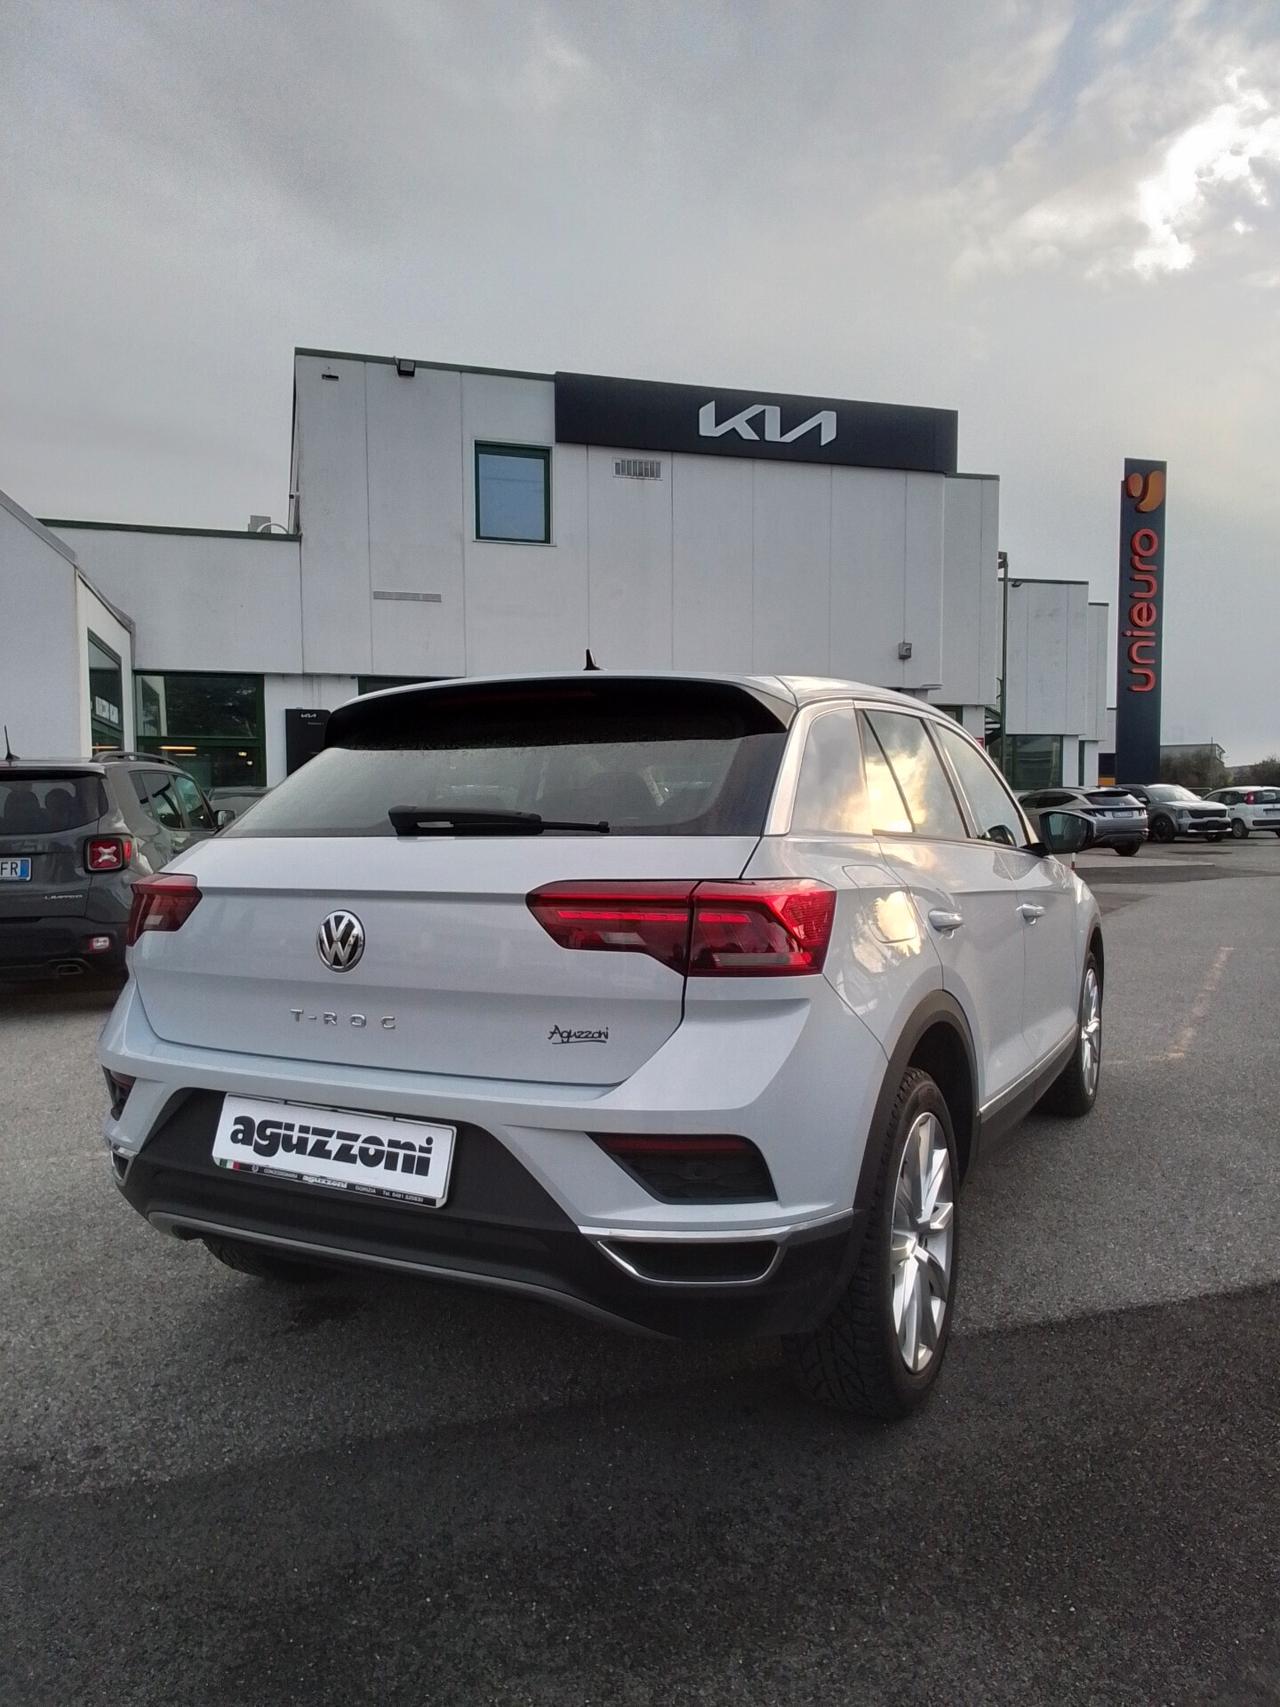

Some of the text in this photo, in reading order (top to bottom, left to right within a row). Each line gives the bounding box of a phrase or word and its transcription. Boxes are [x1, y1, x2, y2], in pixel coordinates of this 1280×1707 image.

[699, 400, 838, 447] KIA
[1125, 528, 1159, 692] unieuro
[0, 862, 19, 876] FR
[290, 1008, 396, 1030] T-ROC
[230, 1115, 433, 1177] aguzzoni
